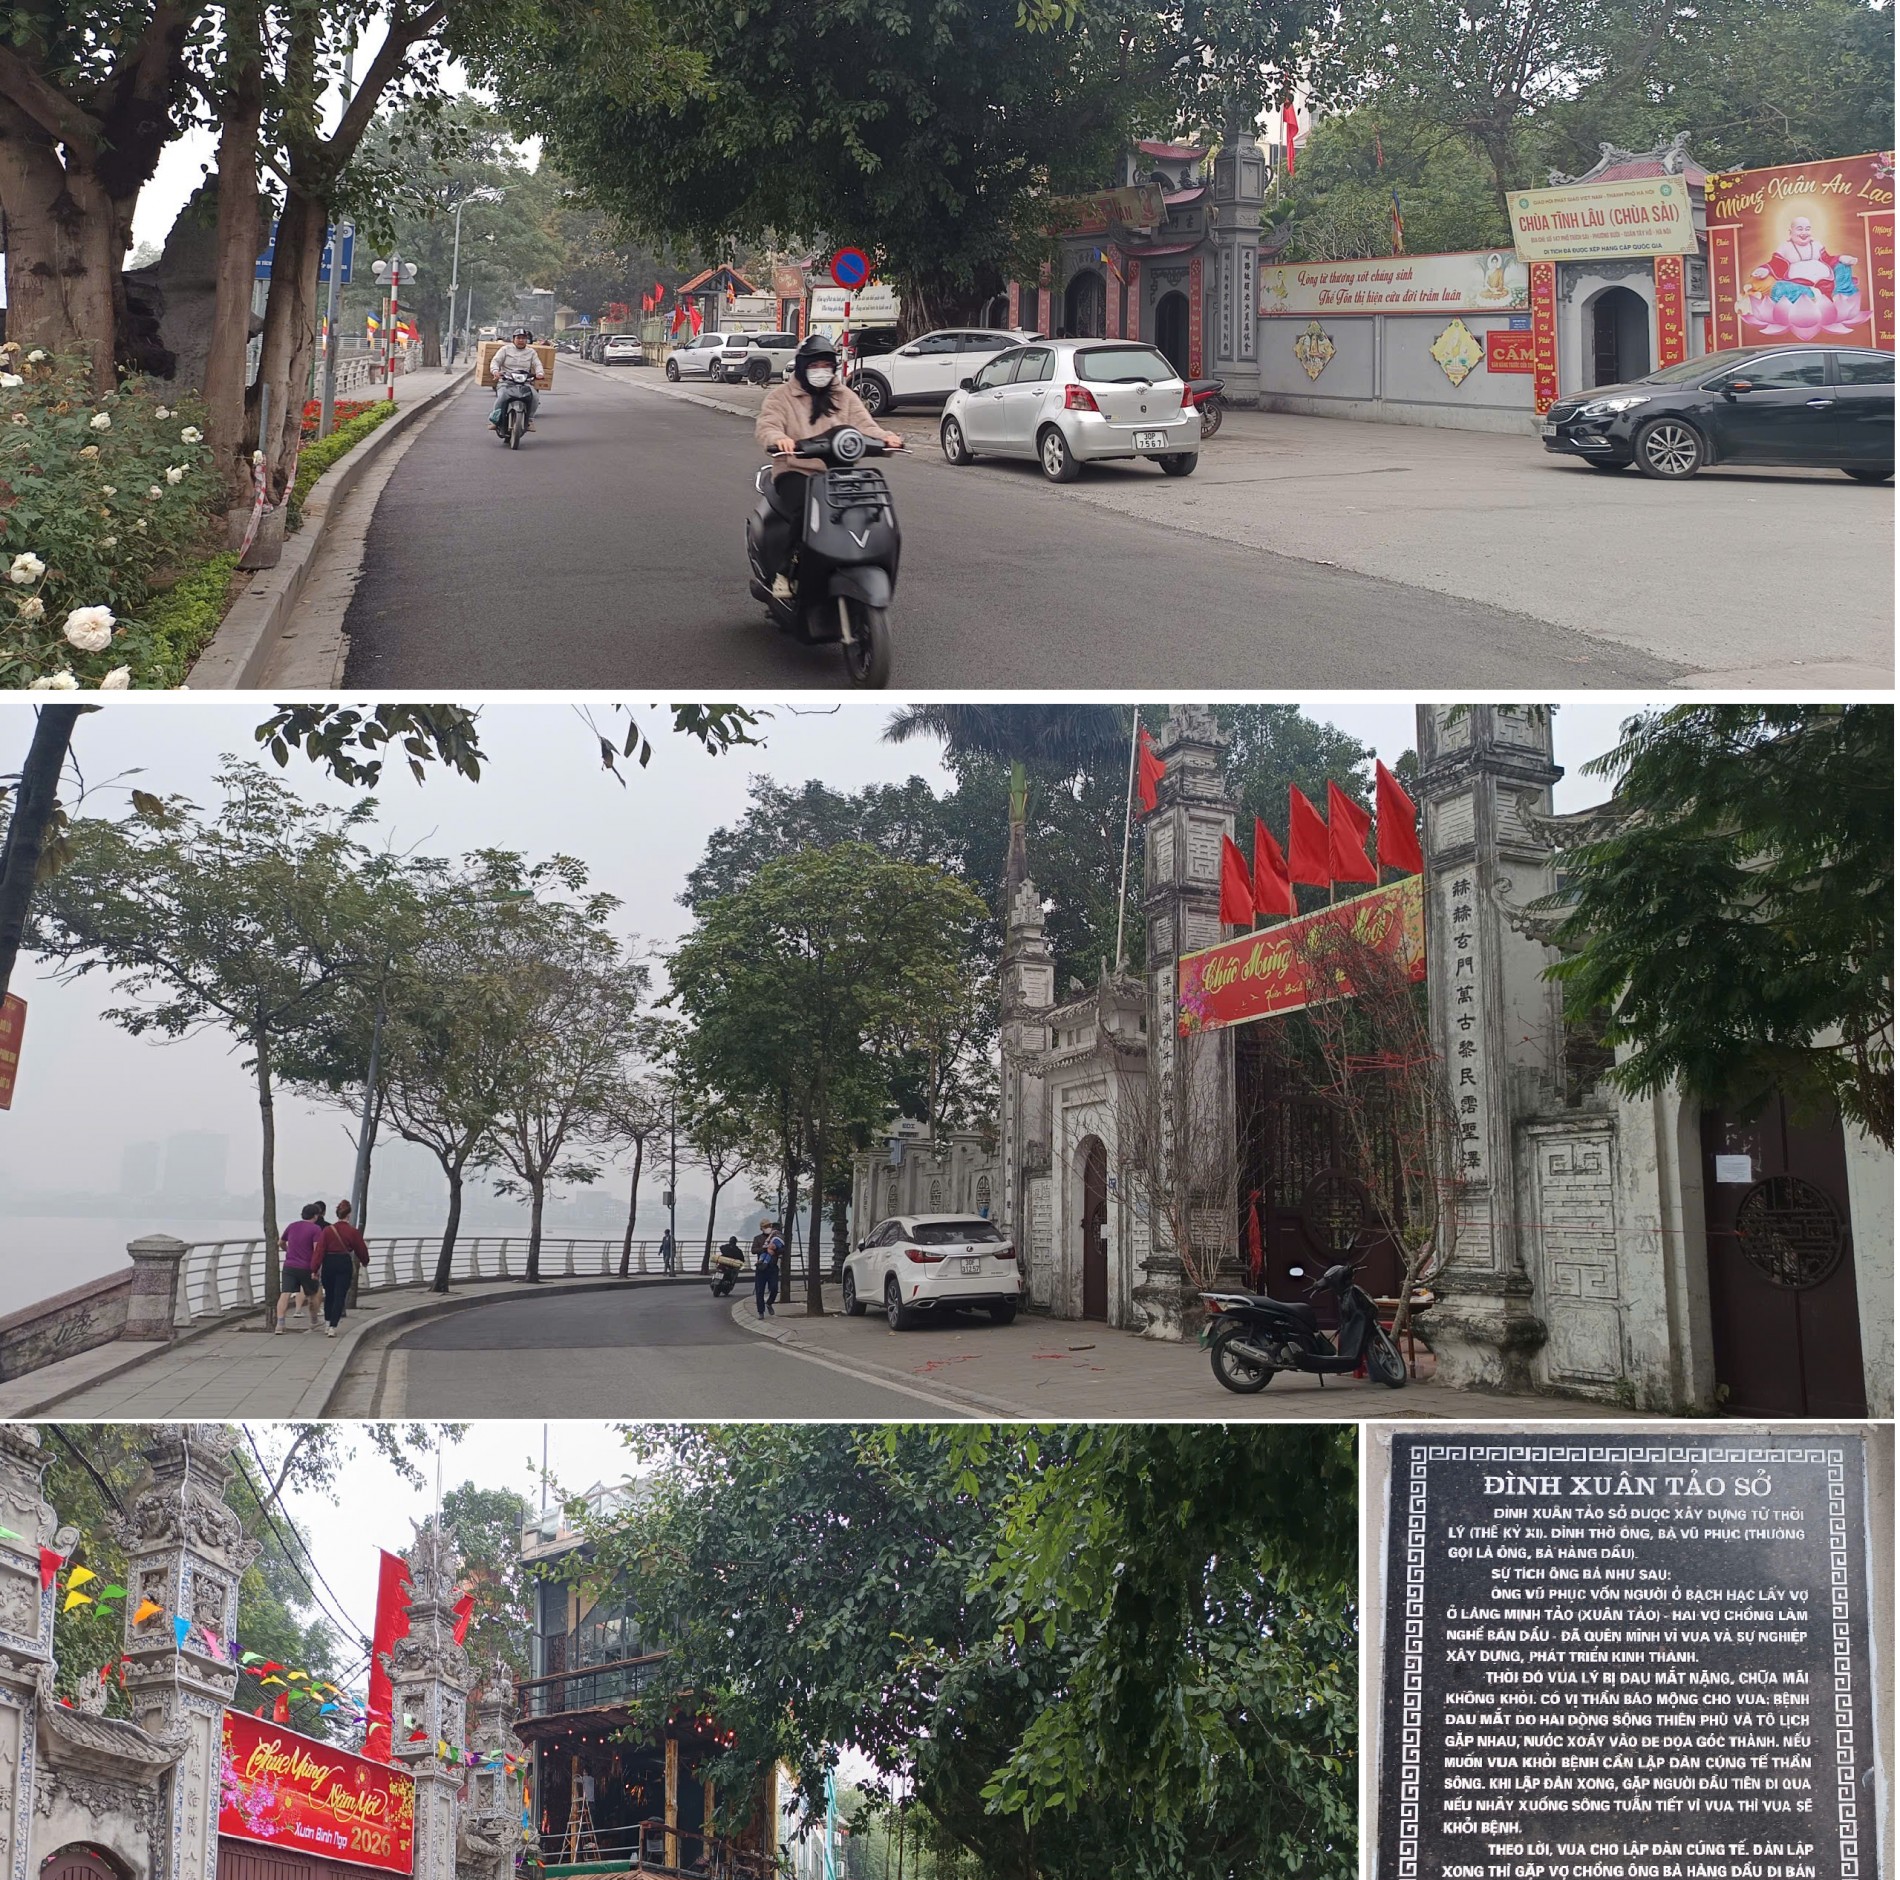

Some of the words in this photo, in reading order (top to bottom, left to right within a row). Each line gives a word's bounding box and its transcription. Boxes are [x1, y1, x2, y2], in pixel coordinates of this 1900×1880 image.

[1715, 186, 1765, 219] Mừng
[1768, 175, 1816, 200] Xuân
[1821, 173, 1853, 195] An
[1857, 178, 1894, 206] Lạc
[1519, 213, 1550, 232] CHÙA
[1551, 211, 1579, 229] TĨNH
[1581, 207, 1605, 227] LÂU
[1610, 204, 1650, 227] (CHÙA
[1492, 343, 1534, 361] CẤM
[1139, 440, 1162, 448] 7567
[1143, 432, 1157, 441] 30P
[1202, 957, 1240, 994] Chúc
[1241, 938, 1293, 981] Mừng
[1483, 1471, 1563, 1496] ĐÌNH
[1569, 1471, 1658, 1496] XUÂN
[1664, 1470, 1726, 1496] TẢO
[1734, 1470, 1772, 1497] SỞ
[1447, 1547, 1473, 1562] GỌI
[1491, 1568, 1511, 1583] SỰ
[1513, 1566, 1545, 1580] TÍCH
[1548, 1566, 1580, 1580] ÔNG
[1582, 1566, 1602, 1580] BÀ
[1605, 1570, 1636, 1580] NHƯ
[1638, 1570, 1672, 1581] SAU:
[246, 1737, 289, 1778] Chúc
[286, 1747, 345, 1791] Mừng
[308, 1784, 356, 1822] Năm
[356, 1788, 388, 1822] Mới
[294, 1822, 315, 1840] Xuân
[316, 1826, 332, 1844] Bính
[333, 1831, 347, 1850] Ngọ
[351, 1826, 391, 1857] 2026
[1443, 1819, 1478, 1834] KHỎI
[1481, 1819, 1523, 1837] BỆNH.
